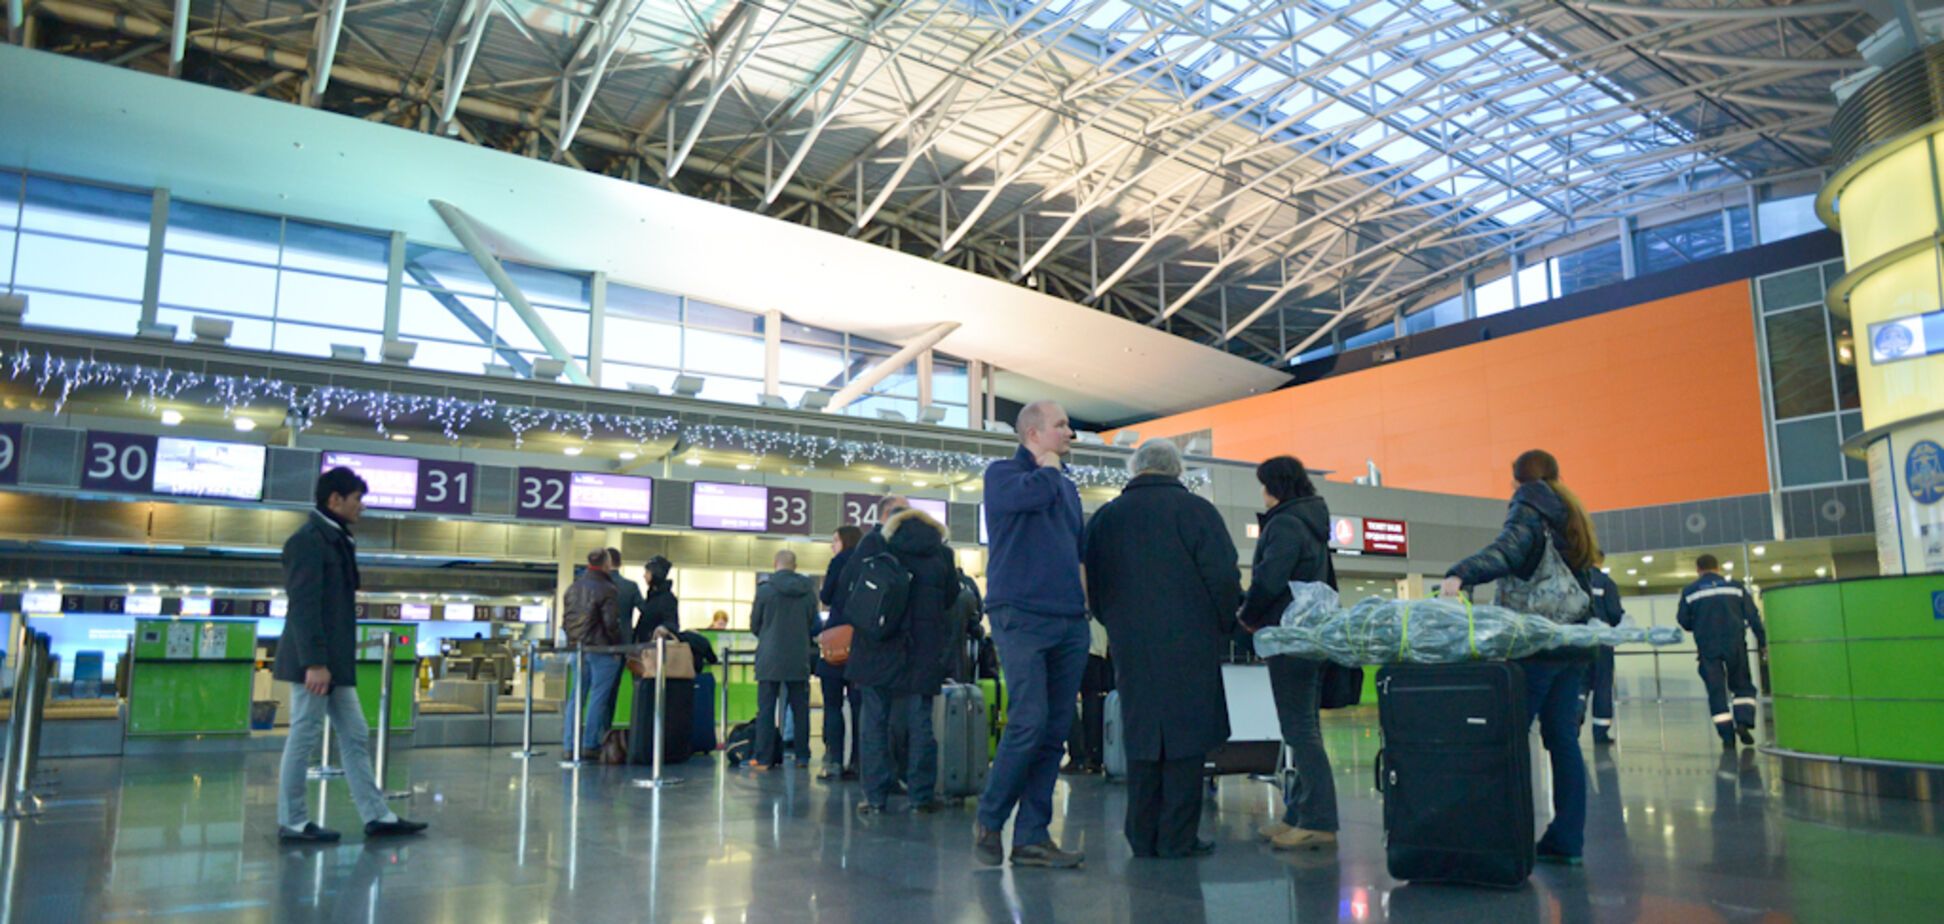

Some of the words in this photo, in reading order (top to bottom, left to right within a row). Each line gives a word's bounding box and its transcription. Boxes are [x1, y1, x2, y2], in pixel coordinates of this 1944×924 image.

[88, 442, 148, 481] 30
[426, 470, 467, 503] 31
[521, 476, 564, 509] 32
[772, 496, 806, 525] 33
[846, 502, 880, 528] 34
[68, 598, 77, 610] 5
[109, 599, 118, 611] 6
[220, 601, 229, 612] 7
[255, 602, 264, 613] 8
[386, 606, 399, 617] 10
[476, 608, 489, 618] 11
[506, 608, 519, 619] 12
